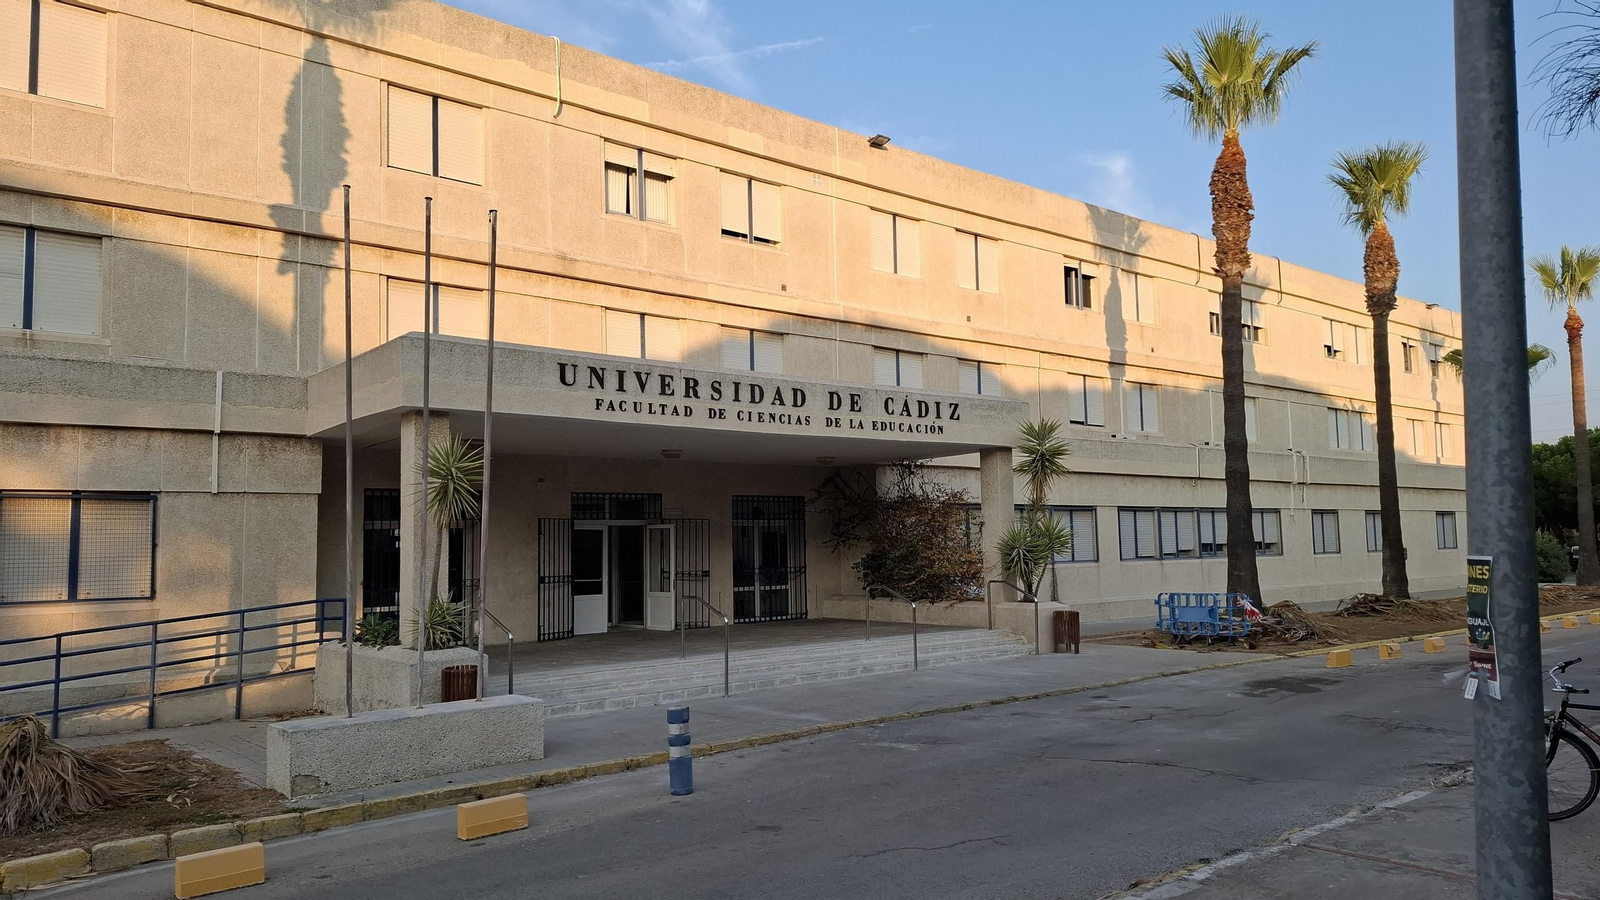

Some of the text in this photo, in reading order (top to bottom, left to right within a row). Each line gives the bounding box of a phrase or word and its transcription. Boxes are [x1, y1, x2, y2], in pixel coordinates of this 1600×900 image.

[557, 362, 961, 421] UNIVERSIDAD DE CÁDIZ
[595, 398, 944, 435] FACULTAD DE CIENCIAS DE LA EDUCACIÓN
[1467, 565, 1490, 579] NES
